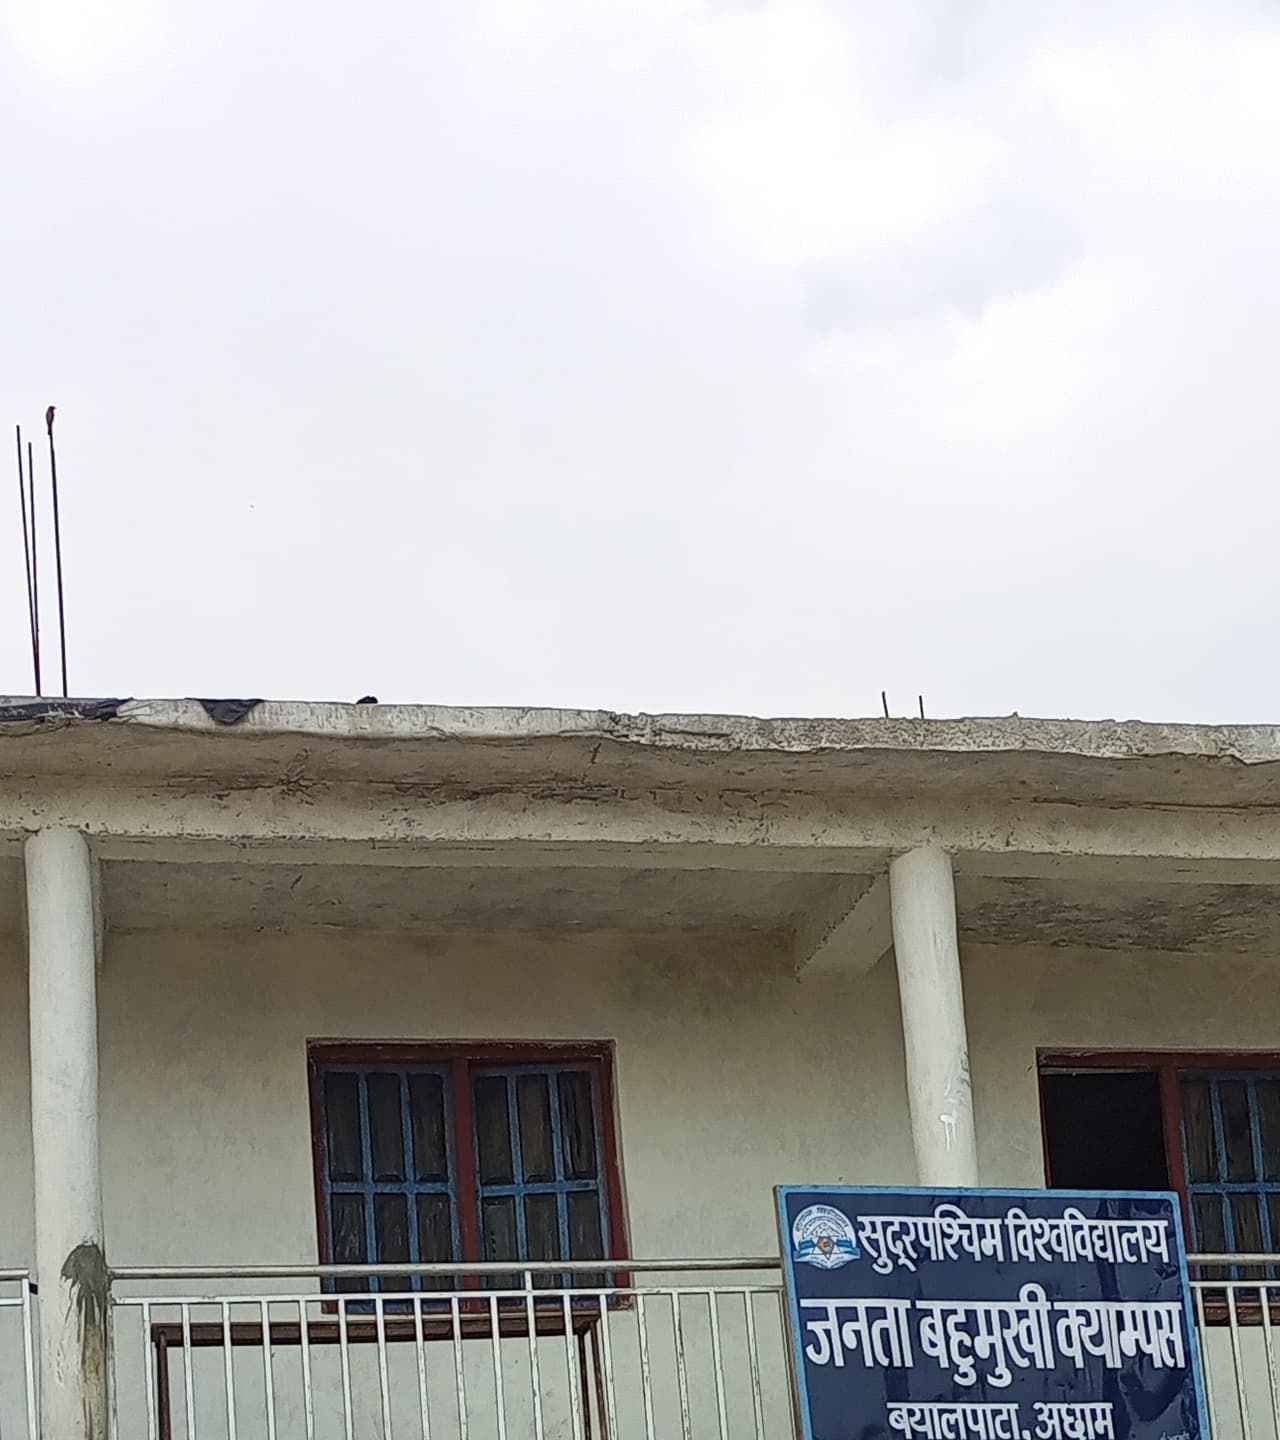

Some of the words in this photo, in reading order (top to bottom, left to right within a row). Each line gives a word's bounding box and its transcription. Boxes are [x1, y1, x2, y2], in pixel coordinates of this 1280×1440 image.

[857, 1203, 1005, 1275] सुदूरपश्चिम
[1004, 1207, 1170, 1264] विश्वविद्यालय
[800, 1298, 914, 1368] जनता
[915, 1282, 1056, 1388] बहुमुखी
[1053, 1301, 1186, 1369] क्याम्पस
